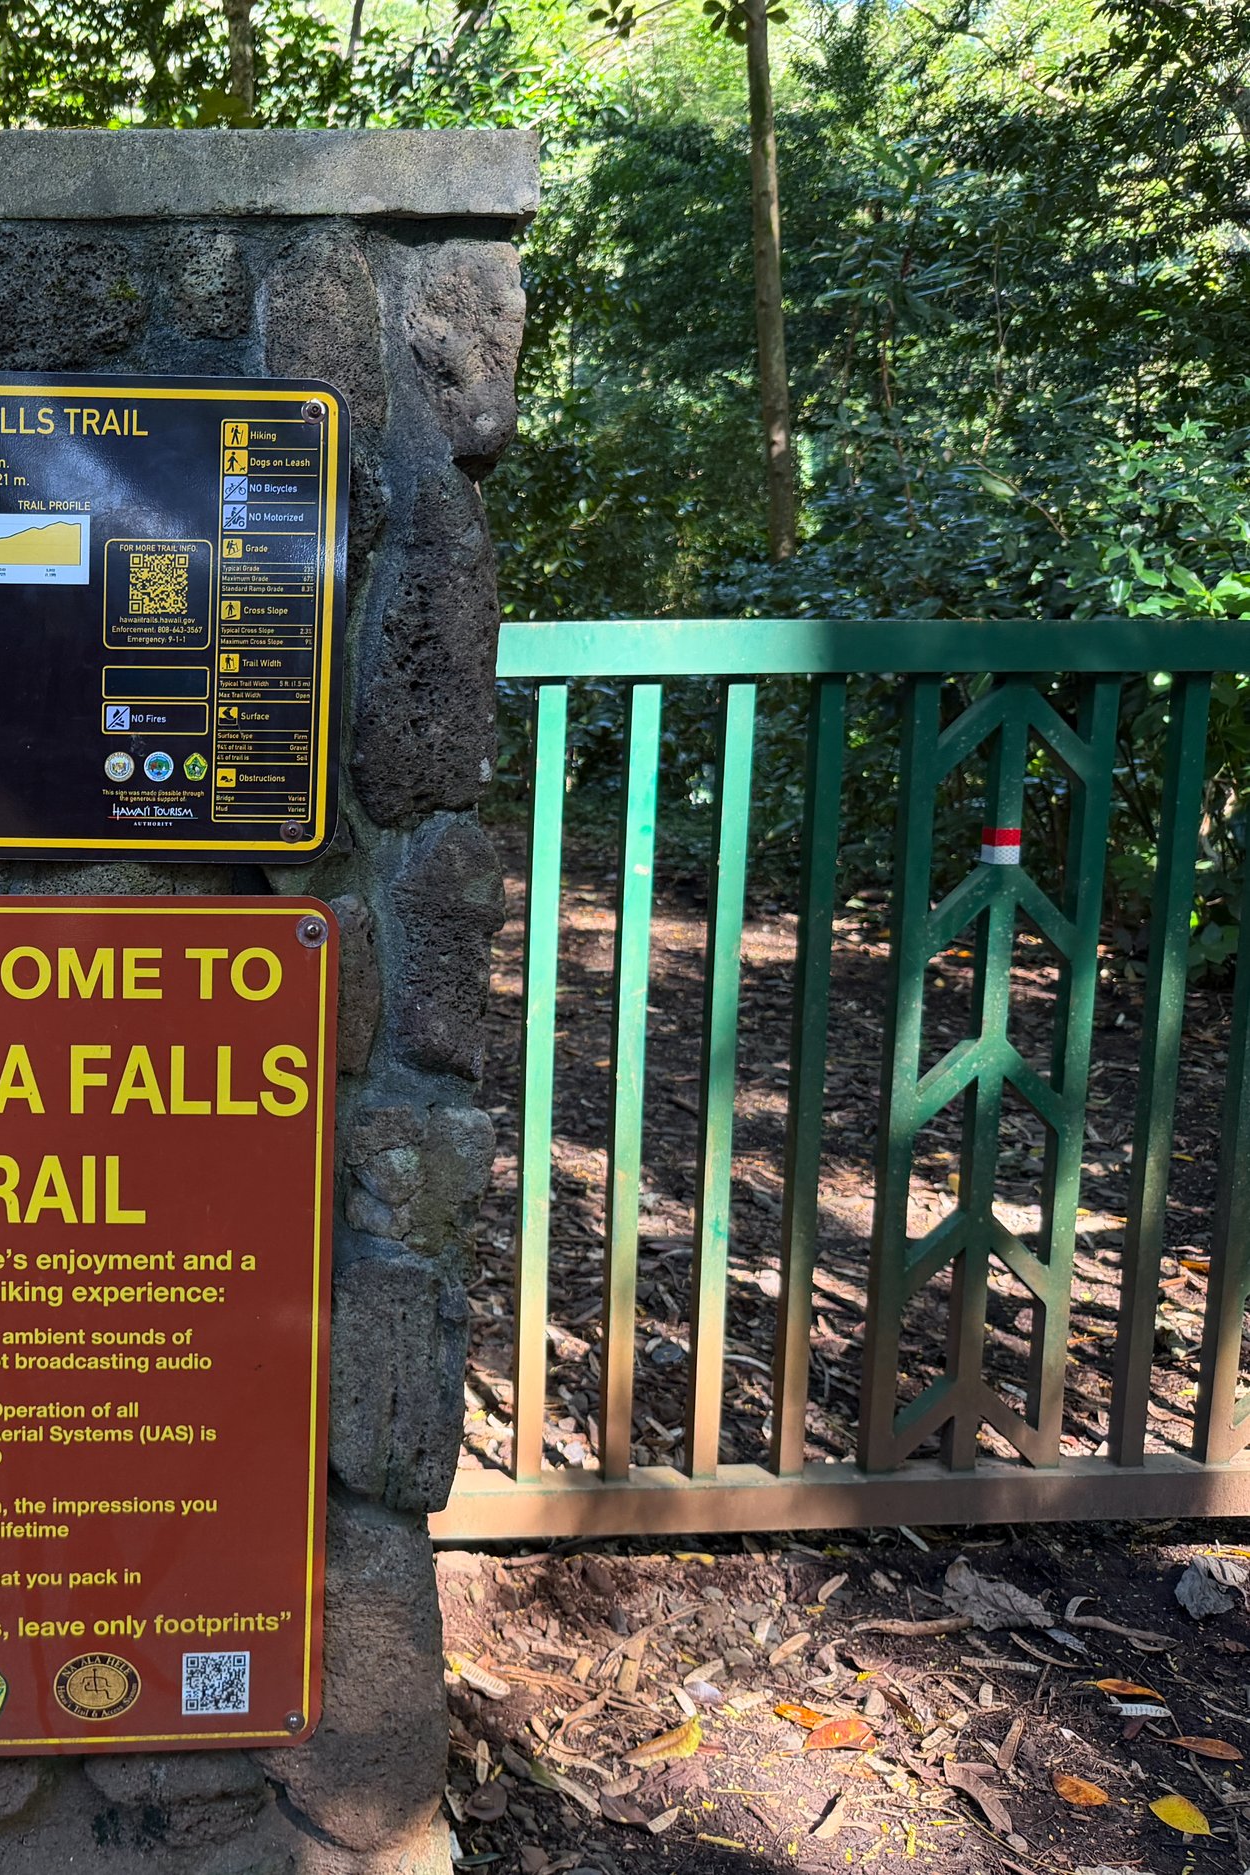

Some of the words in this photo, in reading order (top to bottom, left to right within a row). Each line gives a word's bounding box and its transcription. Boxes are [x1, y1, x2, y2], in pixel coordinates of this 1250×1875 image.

[63, 408, 148, 436] TRAIL
[250, 431, 277, 441] Hiking
[250, 457, 271, 468] Dogs
[285, 458, 310, 467] Leash
[13, 476, 30, 486] m.
[249, 484, 262, 492] NO
[264, 484, 298, 494] Bicycles
[18, 500, 46, 511] TRAIL
[49, 501, 91, 511] PROFILE
[248, 513, 261, 521] NO
[263, 513, 304, 522] Motorized
[119, 544, 134, 552] FOR
[135, 544, 156, 552] MORE
[157, 544, 178, 552] TRAIL
[245, 544, 268, 553] Grade
[243, 606, 265, 615] Cross
[267, 606, 288, 616] Slope
[157, 626, 203, 634] 808-643-3567
[242, 659, 259, 667] Trail
[131, 714, 144, 723] NO
[146, 714, 167, 724] Fires
[240, 712, 270, 720] Surface
[239, 774, 286, 782] Obstructions
[153, 806, 193, 817] TOURISM
[185, 947, 282, 1001] TO
[70, 1044, 309, 1117] FALLS
[36, 1249, 175, 1275] enjoyment
[183, 1250, 233, 1271] and
[240, 1254, 256, 1271] a
[71, 1282, 225, 1307] experience:
[2, 1328, 86, 1345] ambient
[91, 1329, 166, 1345] sounds
[171, 1329, 193, 1345] of
[15, 1353, 149, 1374] broadcasting
[155, 1353, 213, 1370] audio
[91, 1402, 111, 1418] of
[116, 1402, 139, 1418] all
[49, 1426, 133, 1446] Systems
[139, 1425, 194, 1444] (UAS)
[200, 1426, 217, 1441] is
[13, 1497, 47, 1514] the
[52, 1496, 176, 1517] impressions
[181, 1500, 218, 1517] you
[26, 1573, 63, 1590] you
[68, 1569, 119, 1589] pack
[123, 1568, 142, 1585] in
[18, 1617, 86, 1638] leave
[93, 1614, 147, 1639] only
[153, 1610, 292, 1637] footprints”
[81, 1655, 102, 1667] ALA
